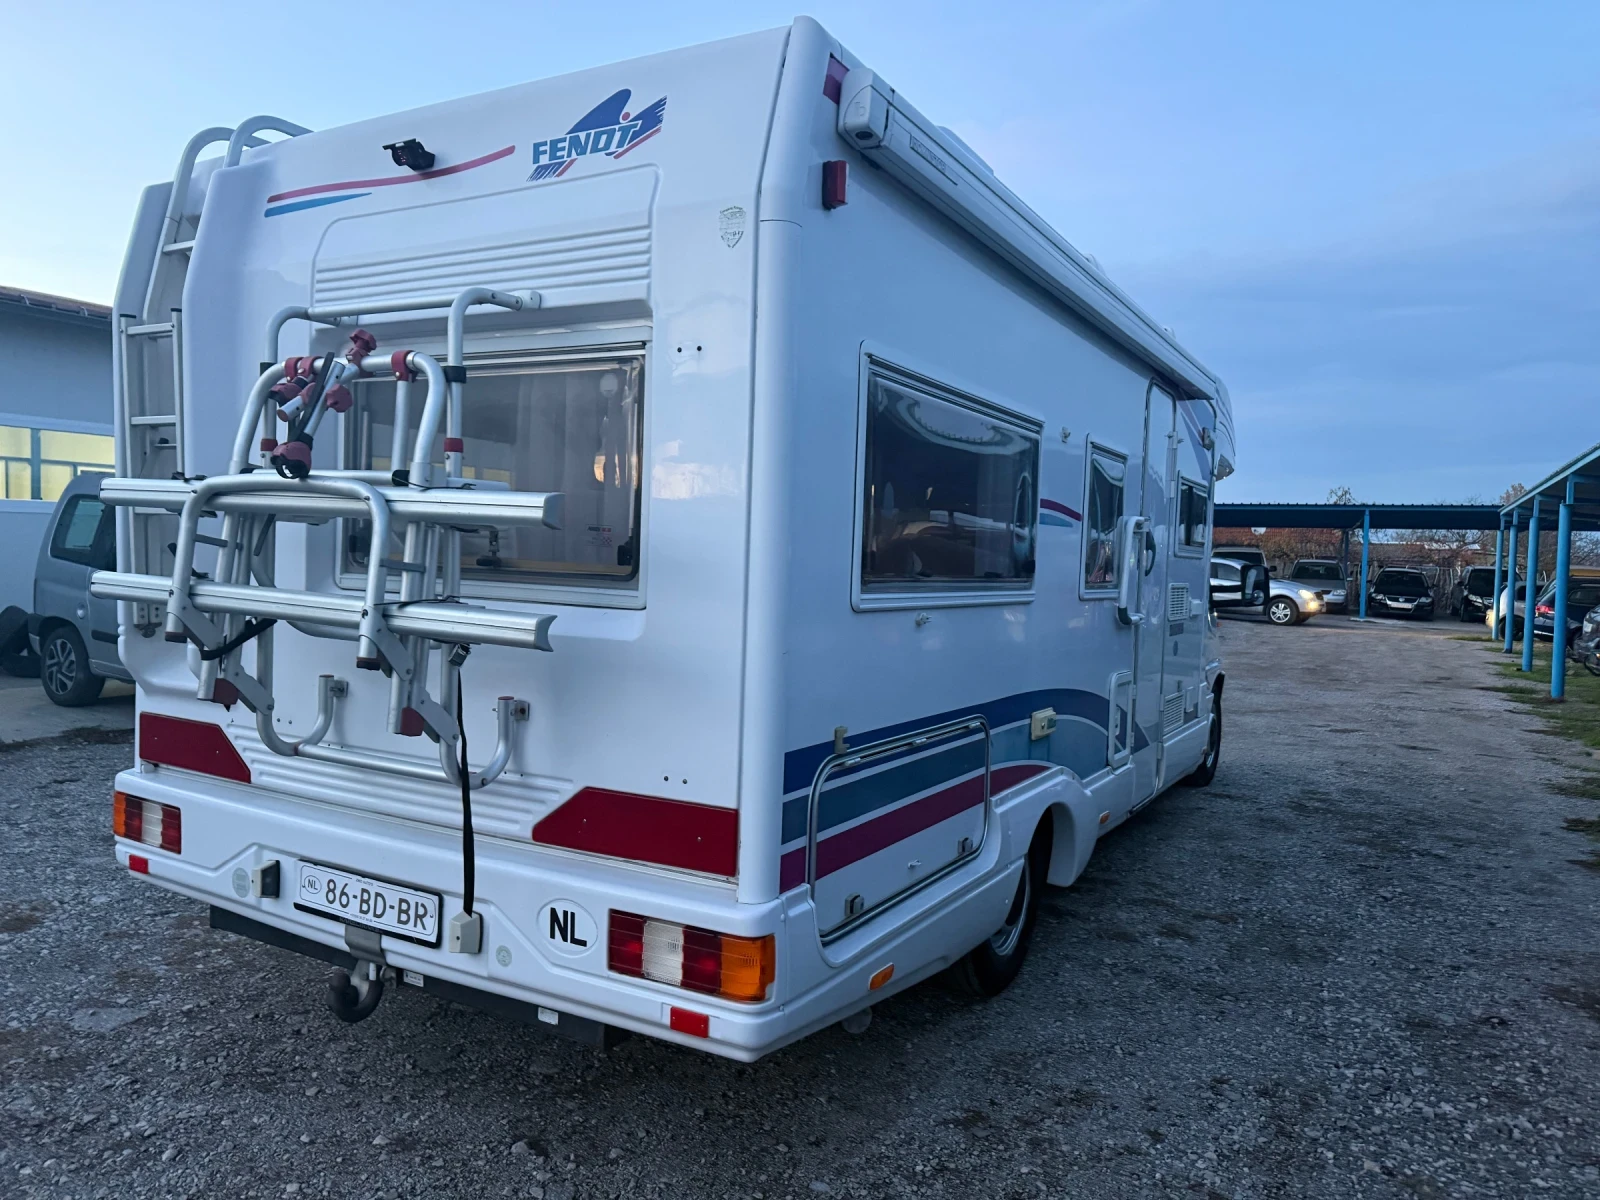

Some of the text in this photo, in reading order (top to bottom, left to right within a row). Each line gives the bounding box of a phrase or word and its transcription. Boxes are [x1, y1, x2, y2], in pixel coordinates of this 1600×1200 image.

[533, 121, 640, 165] FENDT
[307, 878, 318, 891] NL
[325, 878, 428, 931] 86-BD-BR
[549, 906, 588, 948] NL
